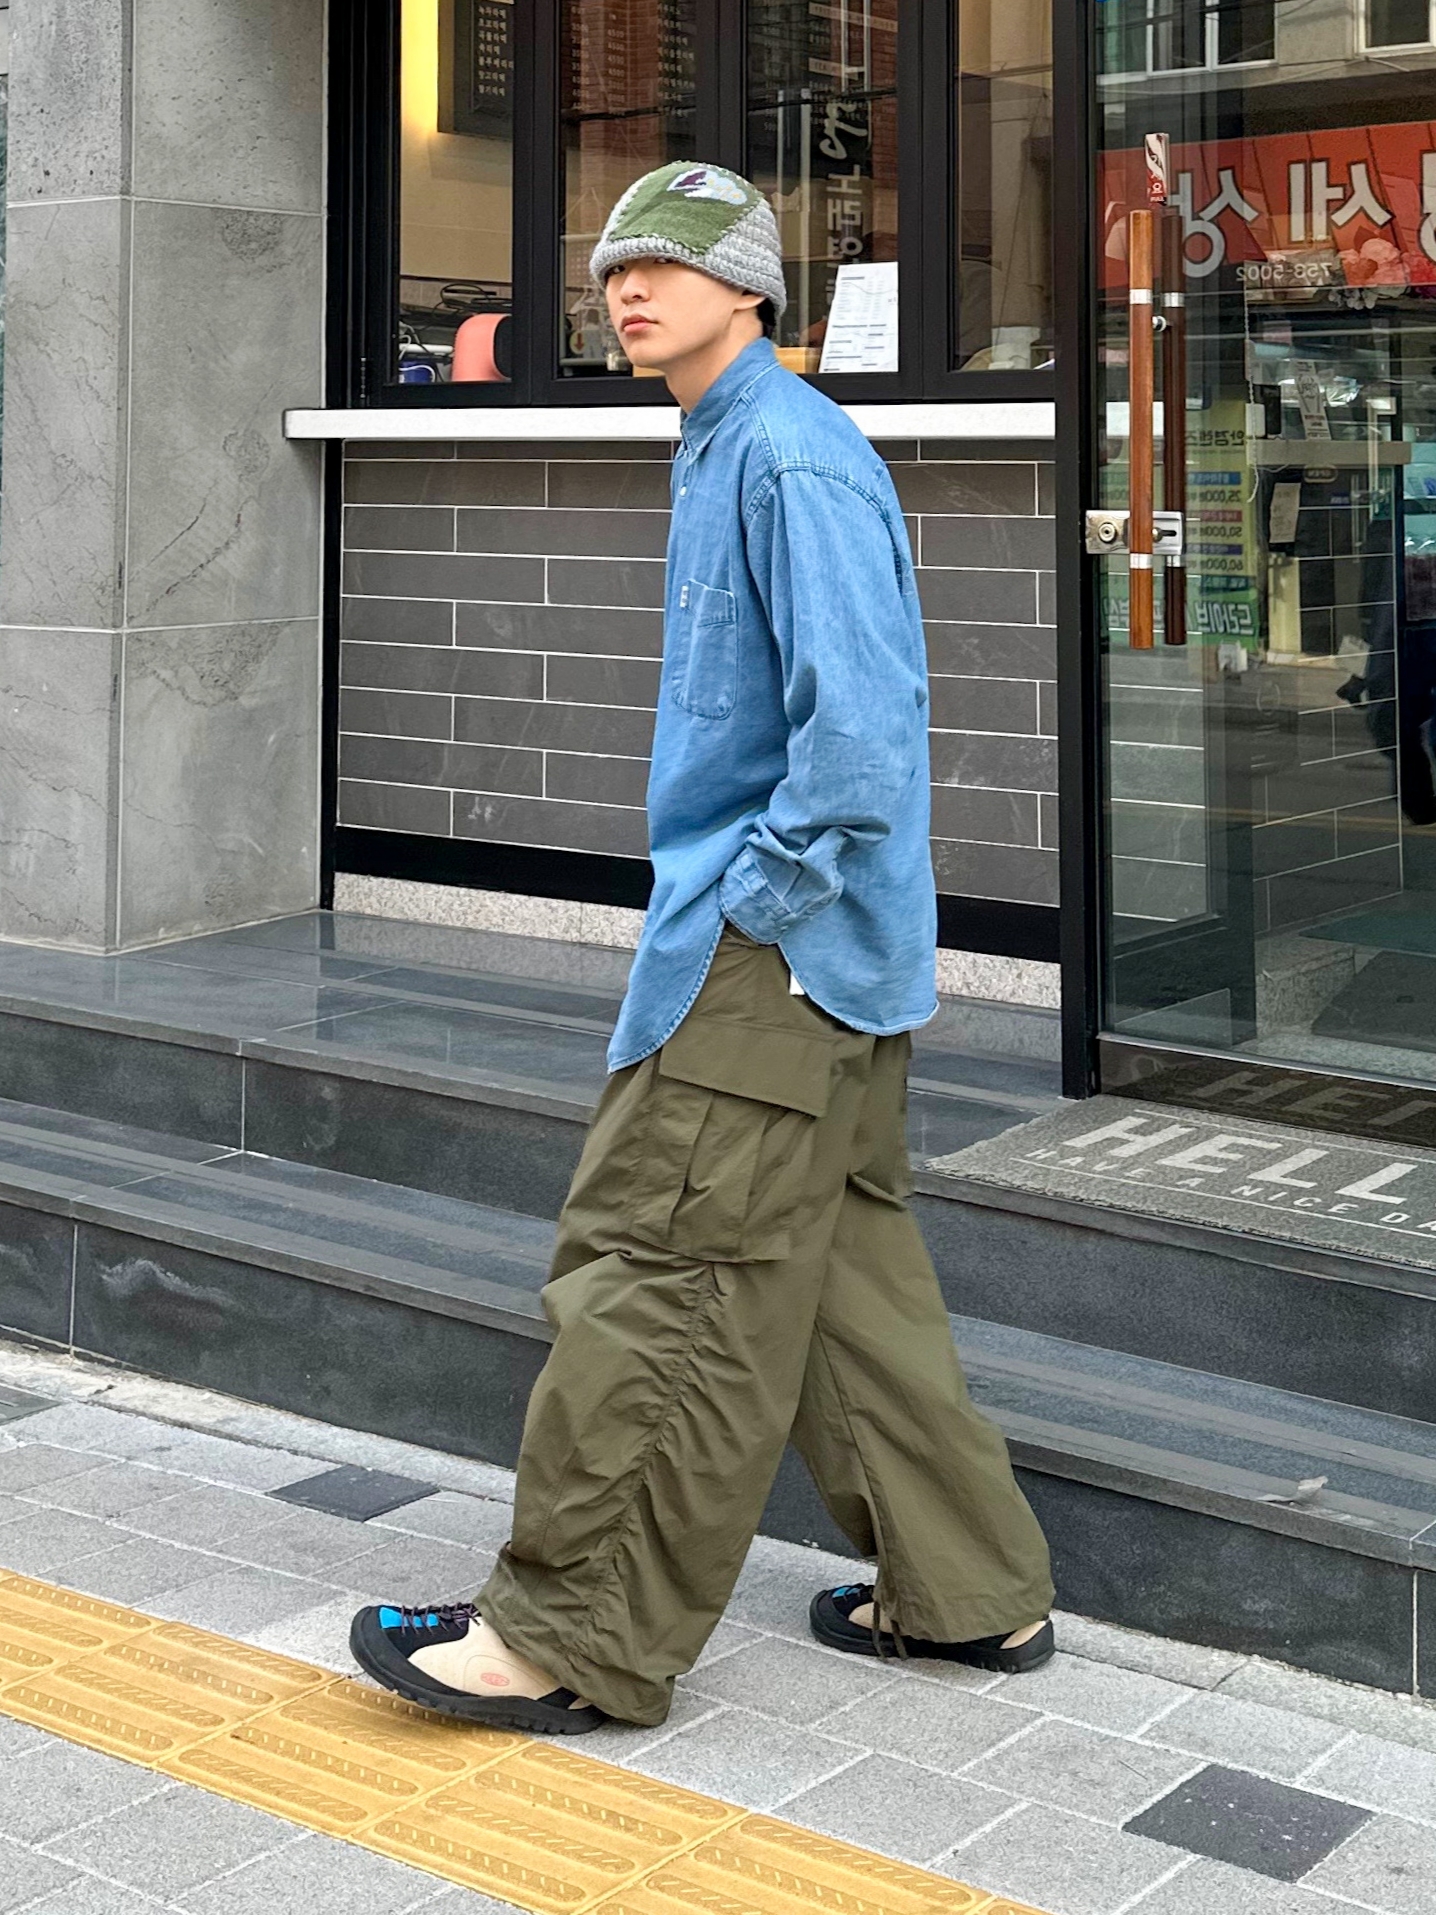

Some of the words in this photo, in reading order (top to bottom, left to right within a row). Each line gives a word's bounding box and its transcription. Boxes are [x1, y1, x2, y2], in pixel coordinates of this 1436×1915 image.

[1024, 1148, 1155, 1179] HAVE
[1176, 1177, 1207, 1189] A
[1230, 1184, 1360, 1215] NICE
